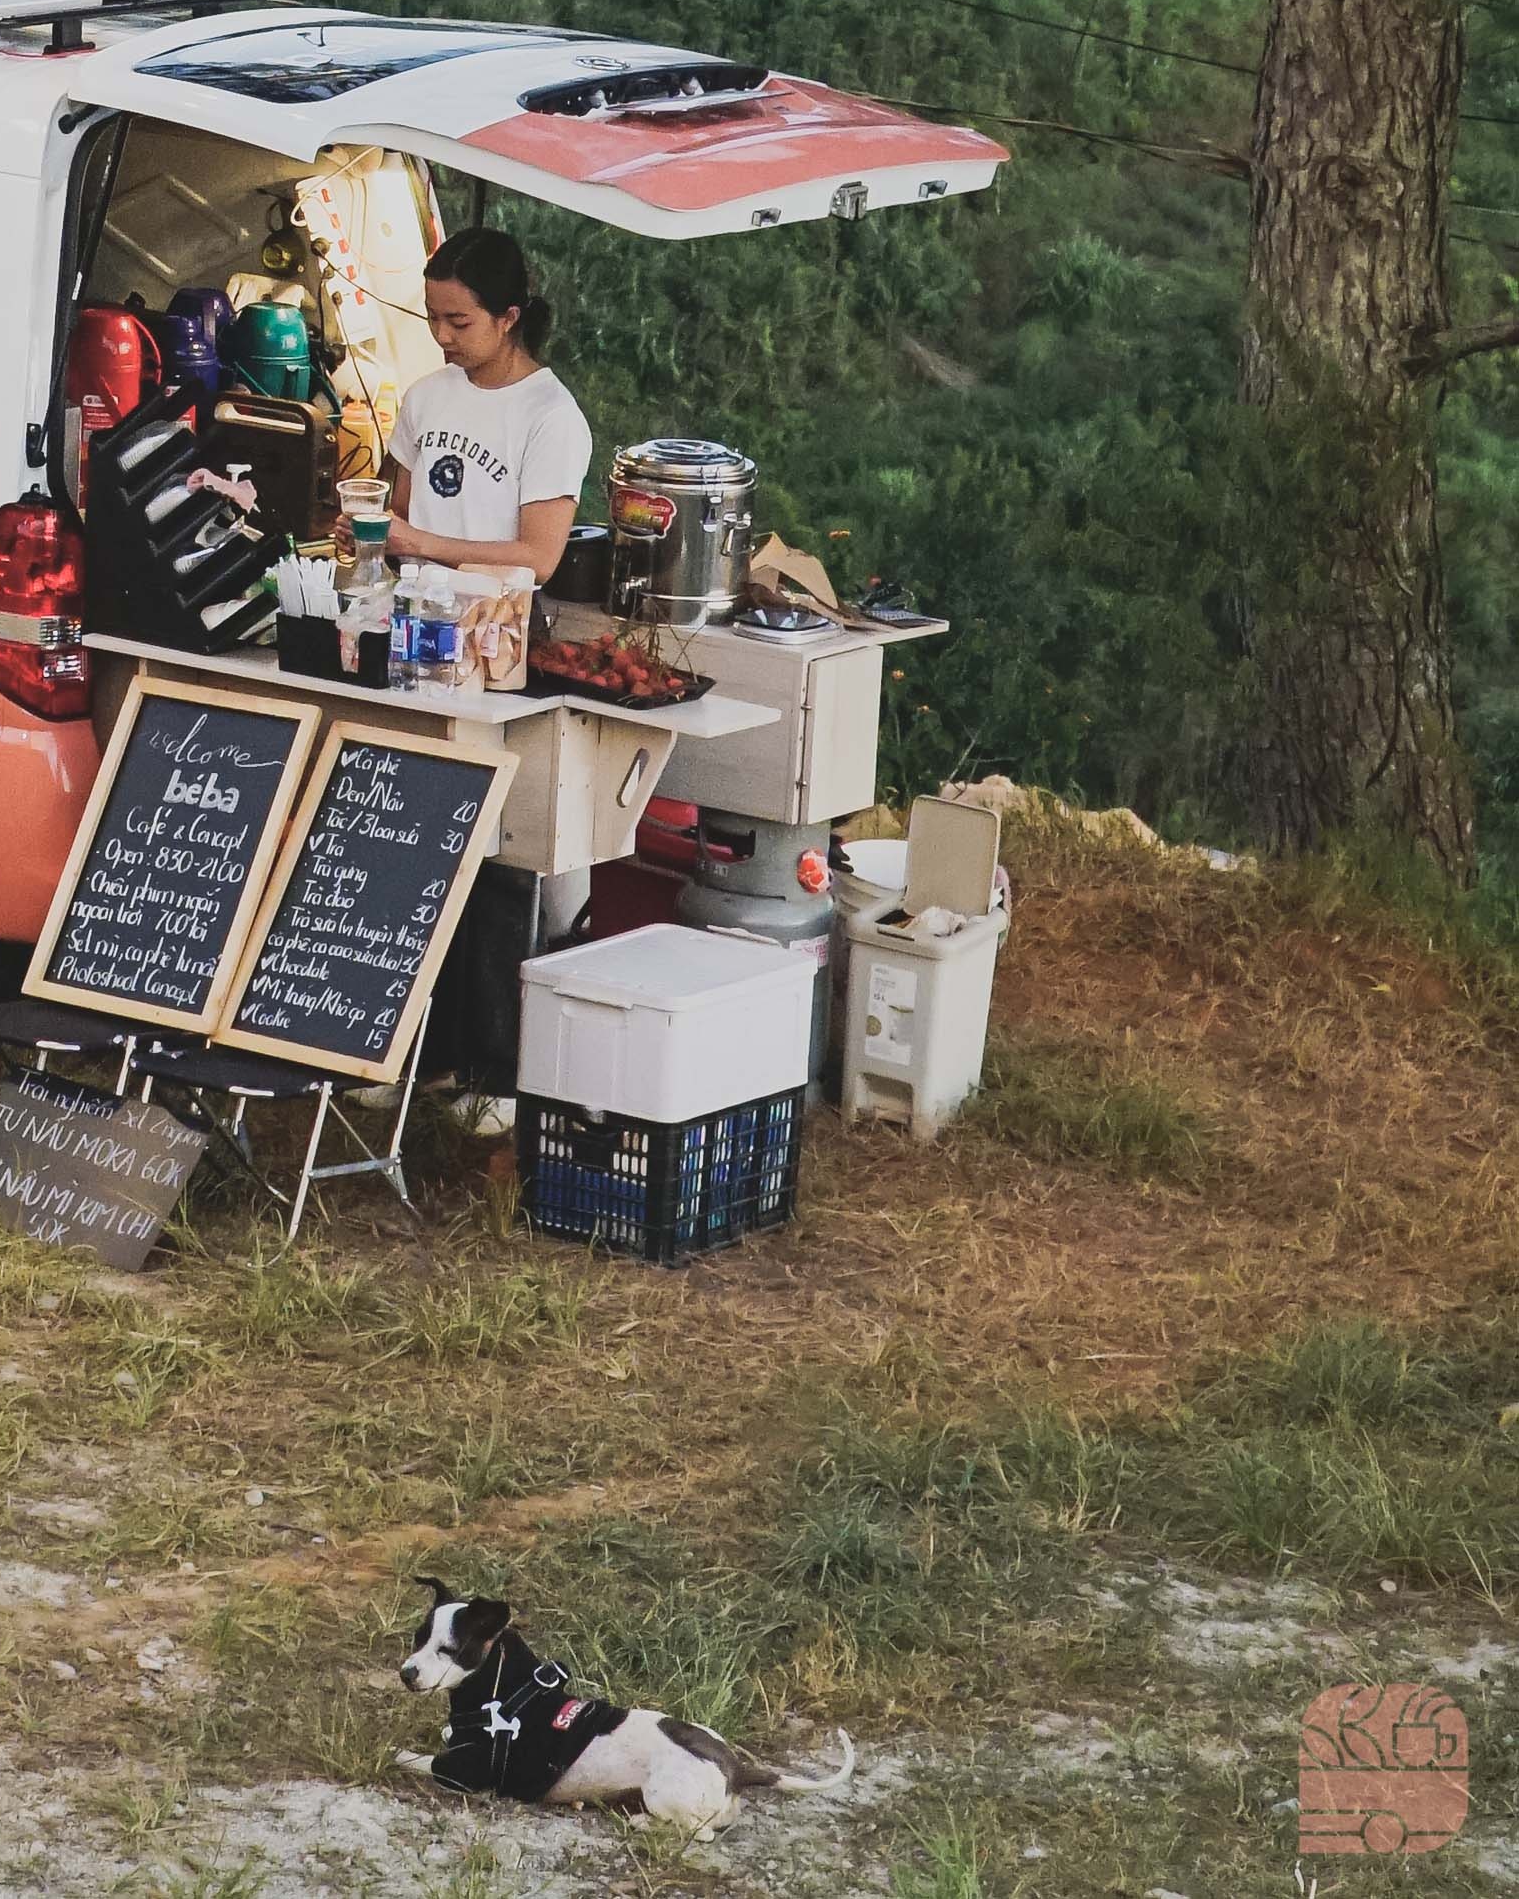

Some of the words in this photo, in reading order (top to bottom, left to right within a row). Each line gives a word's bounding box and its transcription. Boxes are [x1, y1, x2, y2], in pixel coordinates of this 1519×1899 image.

[163, 768, 240, 813] béba
[452, 800, 478, 823] 20
[126, 805, 173, 846] Café
[173, 824, 186, 840] &
[188, 812, 249, 862] Concept
[440, 829, 465, 854] 30
[129, 872, 175, 909] phim
[422, 877, 446, 899] 20
[410, 903, 437, 924] 30
[56, 955, 141, 992] Photoshoot
[271, 953, 330, 981] Chocolate
[385, 979, 410, 998] 25
[251, 1003, 291, 1028] Cookie
[365, 1028, 389, 1049] 15
[374, 1008, 397, 1027] 20
[72, 1134, 137, 1177] MOKA
[141, 1154, 185, 1188] 60K
[26, 1212, 71, 1246] 50K
[72, 1196, 119, 1230] KIM
